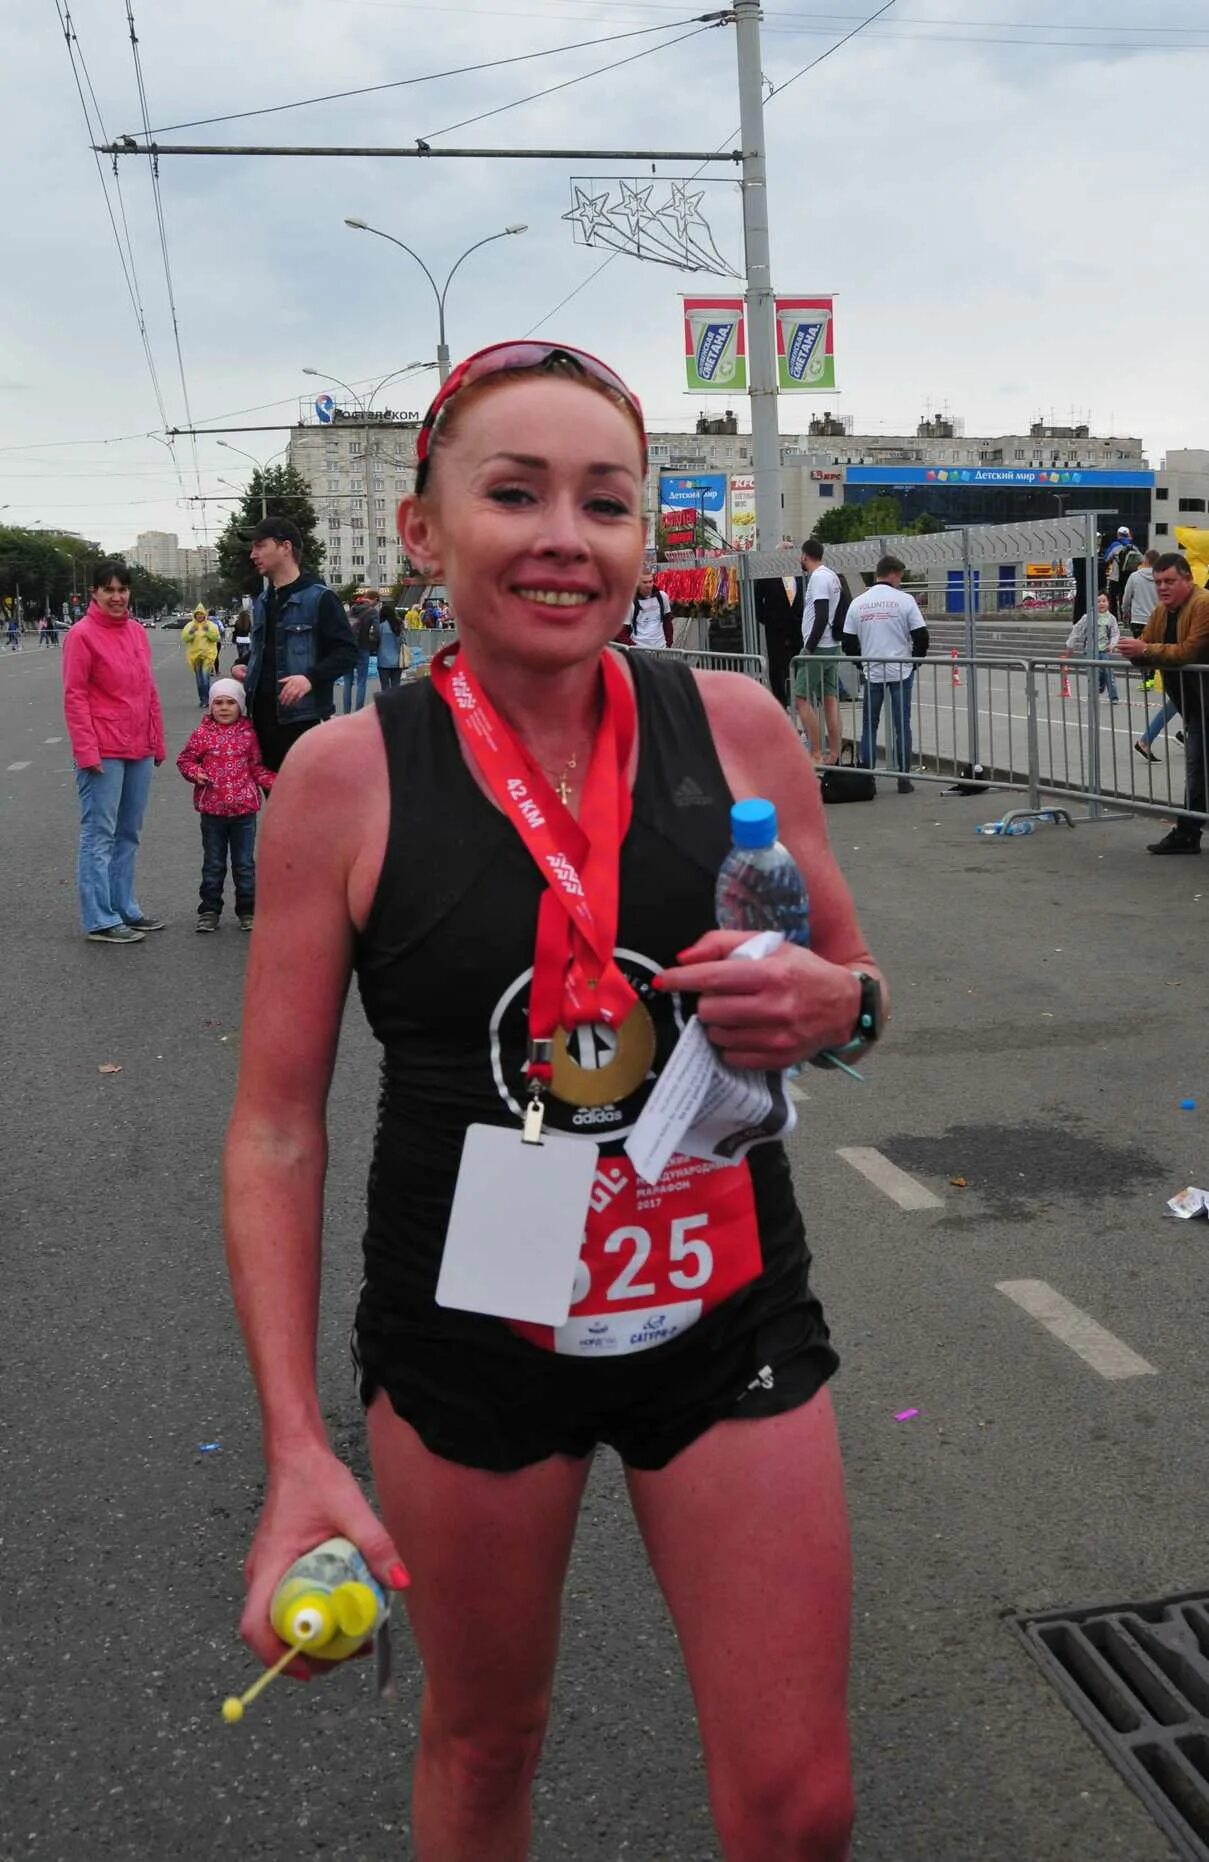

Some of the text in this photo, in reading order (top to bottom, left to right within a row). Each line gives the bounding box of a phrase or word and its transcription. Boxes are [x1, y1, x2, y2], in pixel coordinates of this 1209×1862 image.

[975, 470, 1035, 483] Детский мир
[507, 778, 545, 828] 42 KM
[572, 1109, 622, 1125] adidas
[637, 1181, 690, 1198] МАРАФОН
[637, 1198, 662, 1211] 2017
